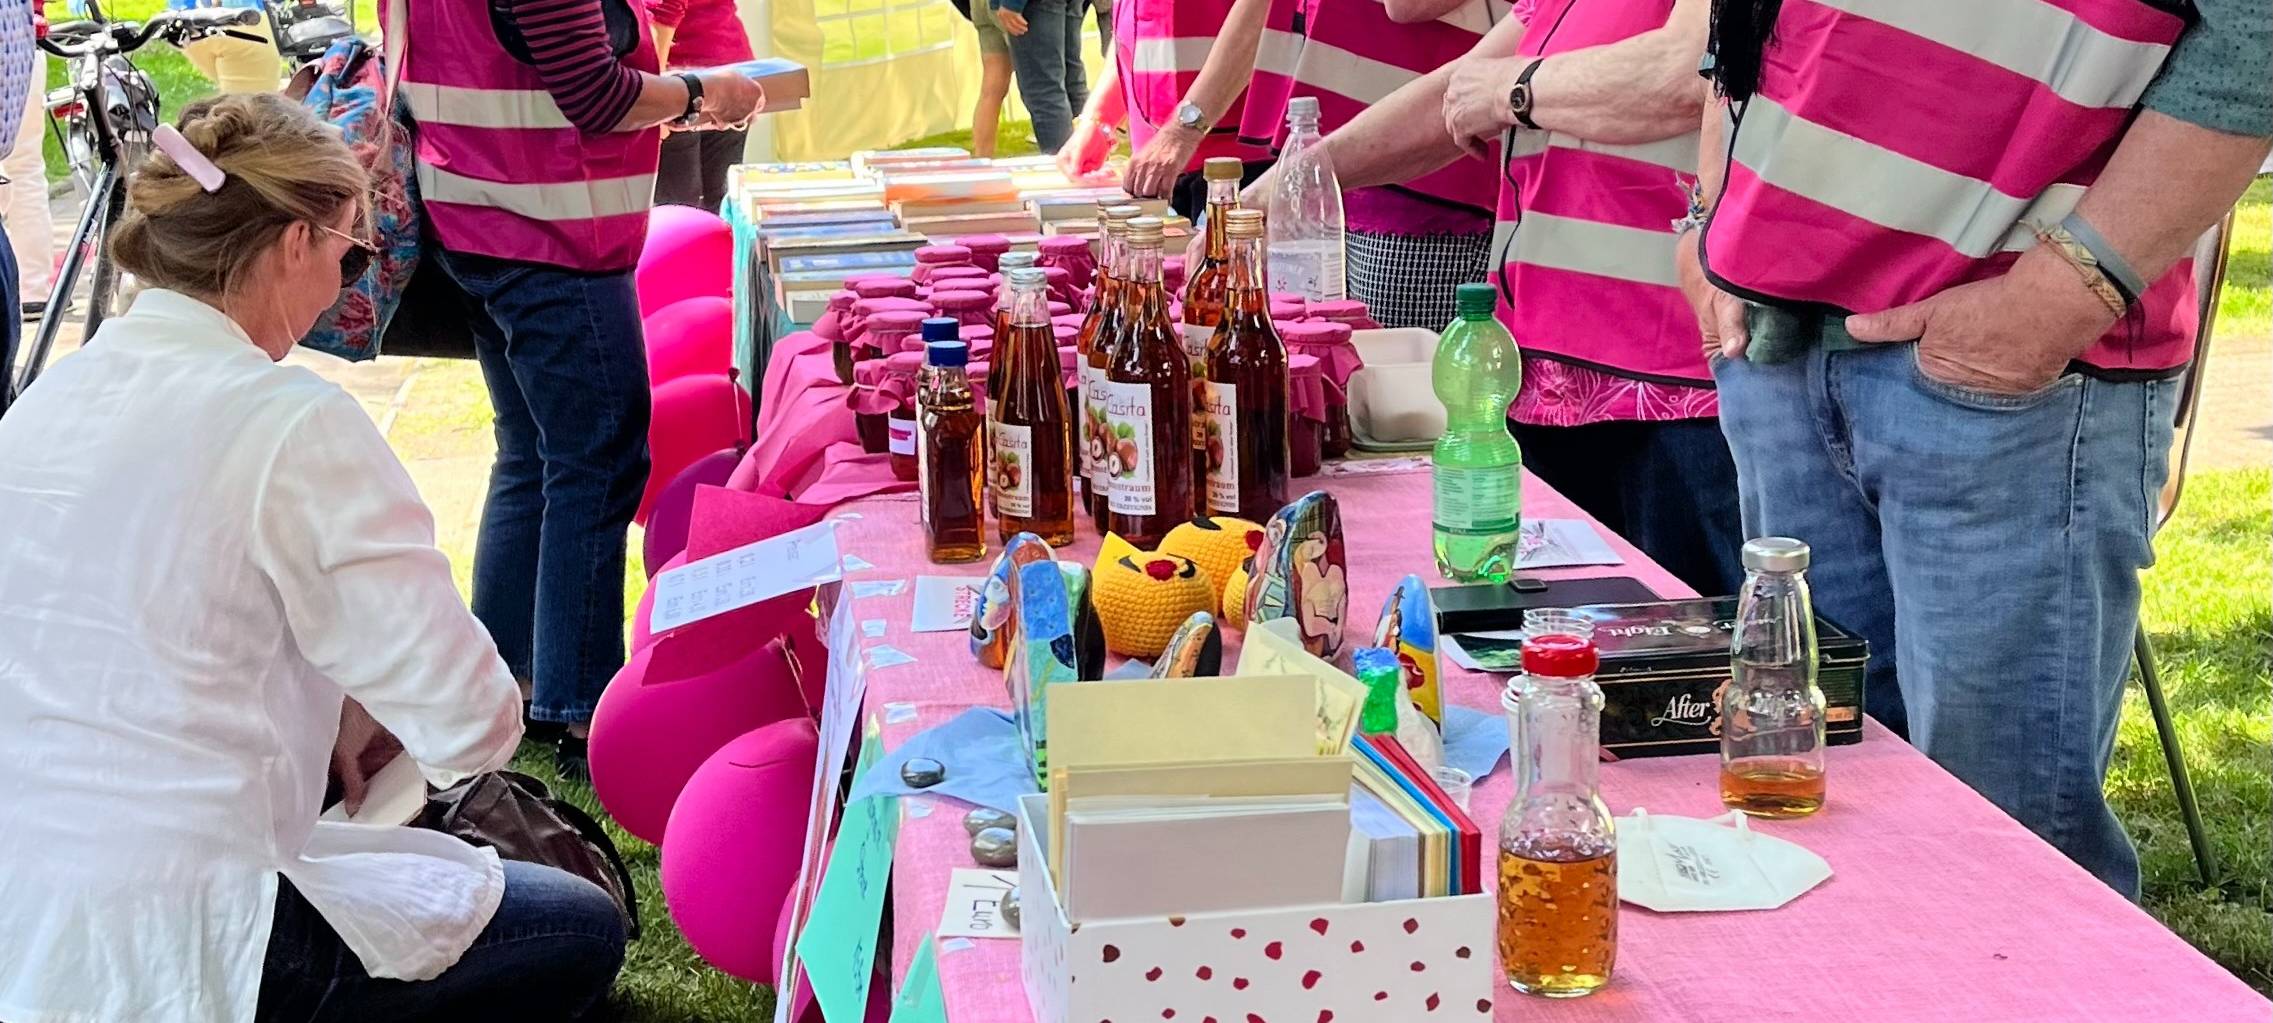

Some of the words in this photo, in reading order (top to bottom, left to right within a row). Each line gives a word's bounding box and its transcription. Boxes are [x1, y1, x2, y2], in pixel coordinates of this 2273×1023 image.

[1106, 394, 1146, 416] Casita
[1652, 693, 1711, 726] After
[969, 899, 1001, 930] Euro
